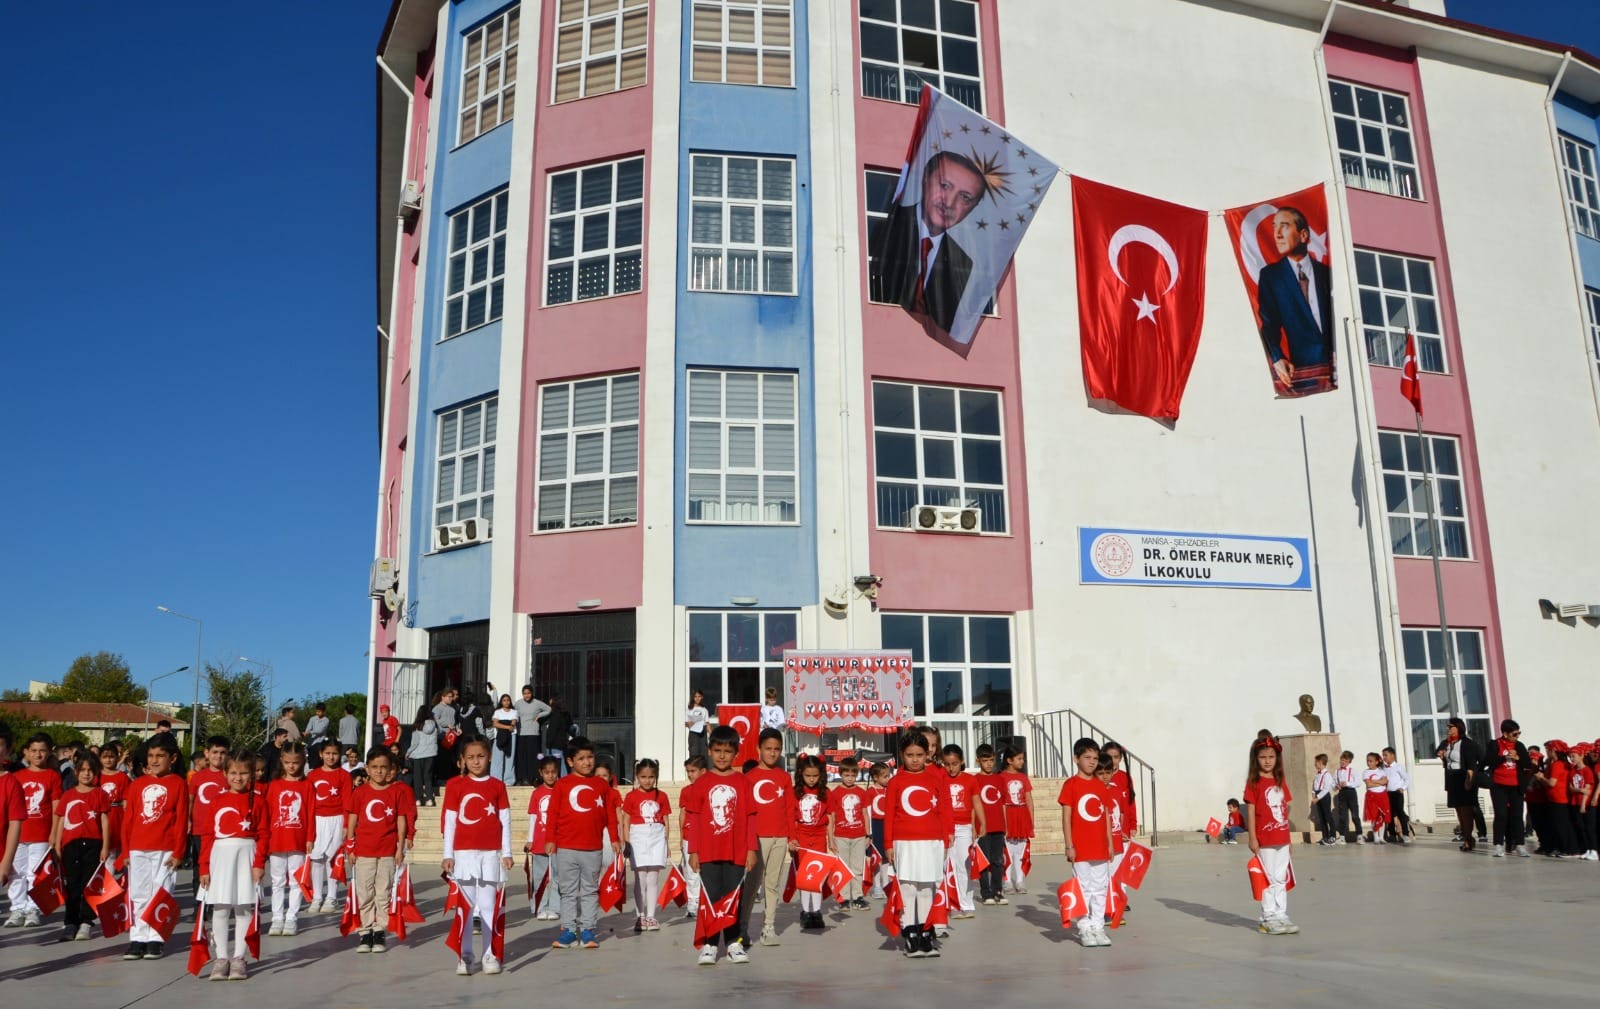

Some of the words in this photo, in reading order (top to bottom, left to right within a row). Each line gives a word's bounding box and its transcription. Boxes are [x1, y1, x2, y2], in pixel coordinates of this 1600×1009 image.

[1173, 538, 1220, 548] ŞEHZADELER
[1143, 548, 1165, 561] DR.
[1169, 547, 1206, 563] ÖMER
[1210, 551, 1252, 564] FARUK
[1255, 552, 1294, 569] MERİÇ
[1144, 563, 1212, 579] İLKOKULU
